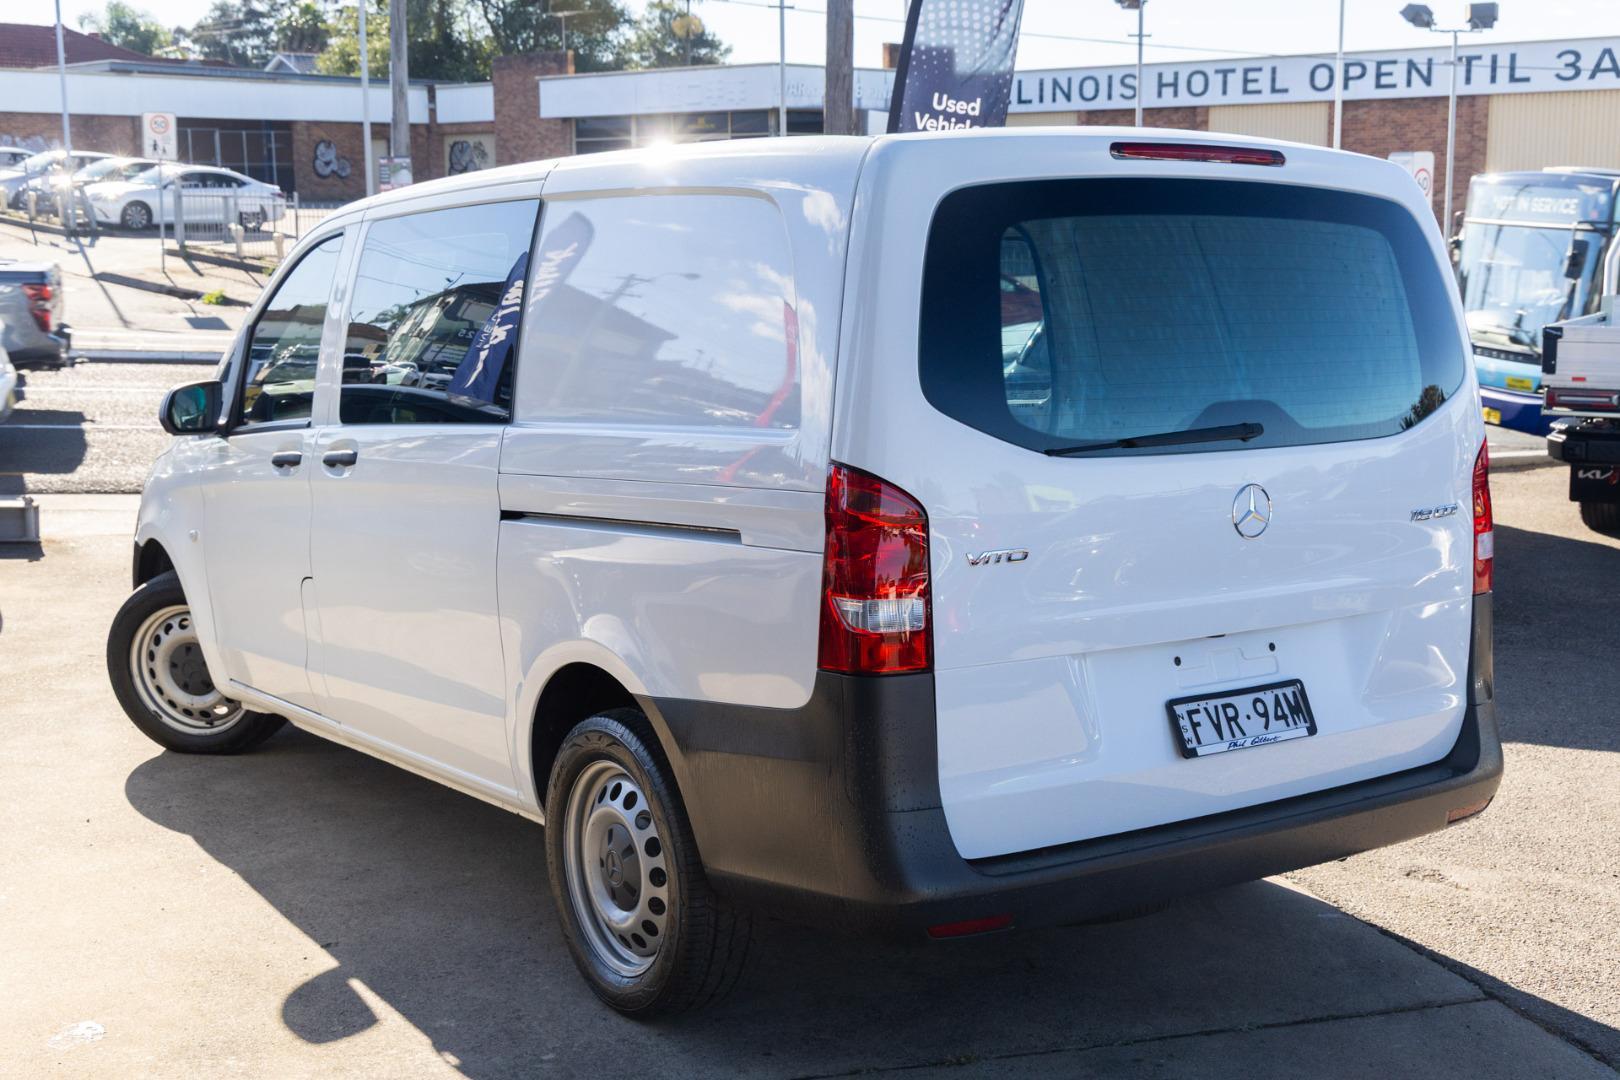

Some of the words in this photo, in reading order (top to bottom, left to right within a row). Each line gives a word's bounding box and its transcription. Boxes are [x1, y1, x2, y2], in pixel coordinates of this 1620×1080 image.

[1009, 73, 1137, 104] LINOIS
[1157, 66, 1289, 98] HOTEL
[1309, 58, 1433, 92] OPEN
[932, 92, 981, 116] Used
[1531, 196, 1579, 214] SERVICE
[966, 548, 1029, 566] VITO
